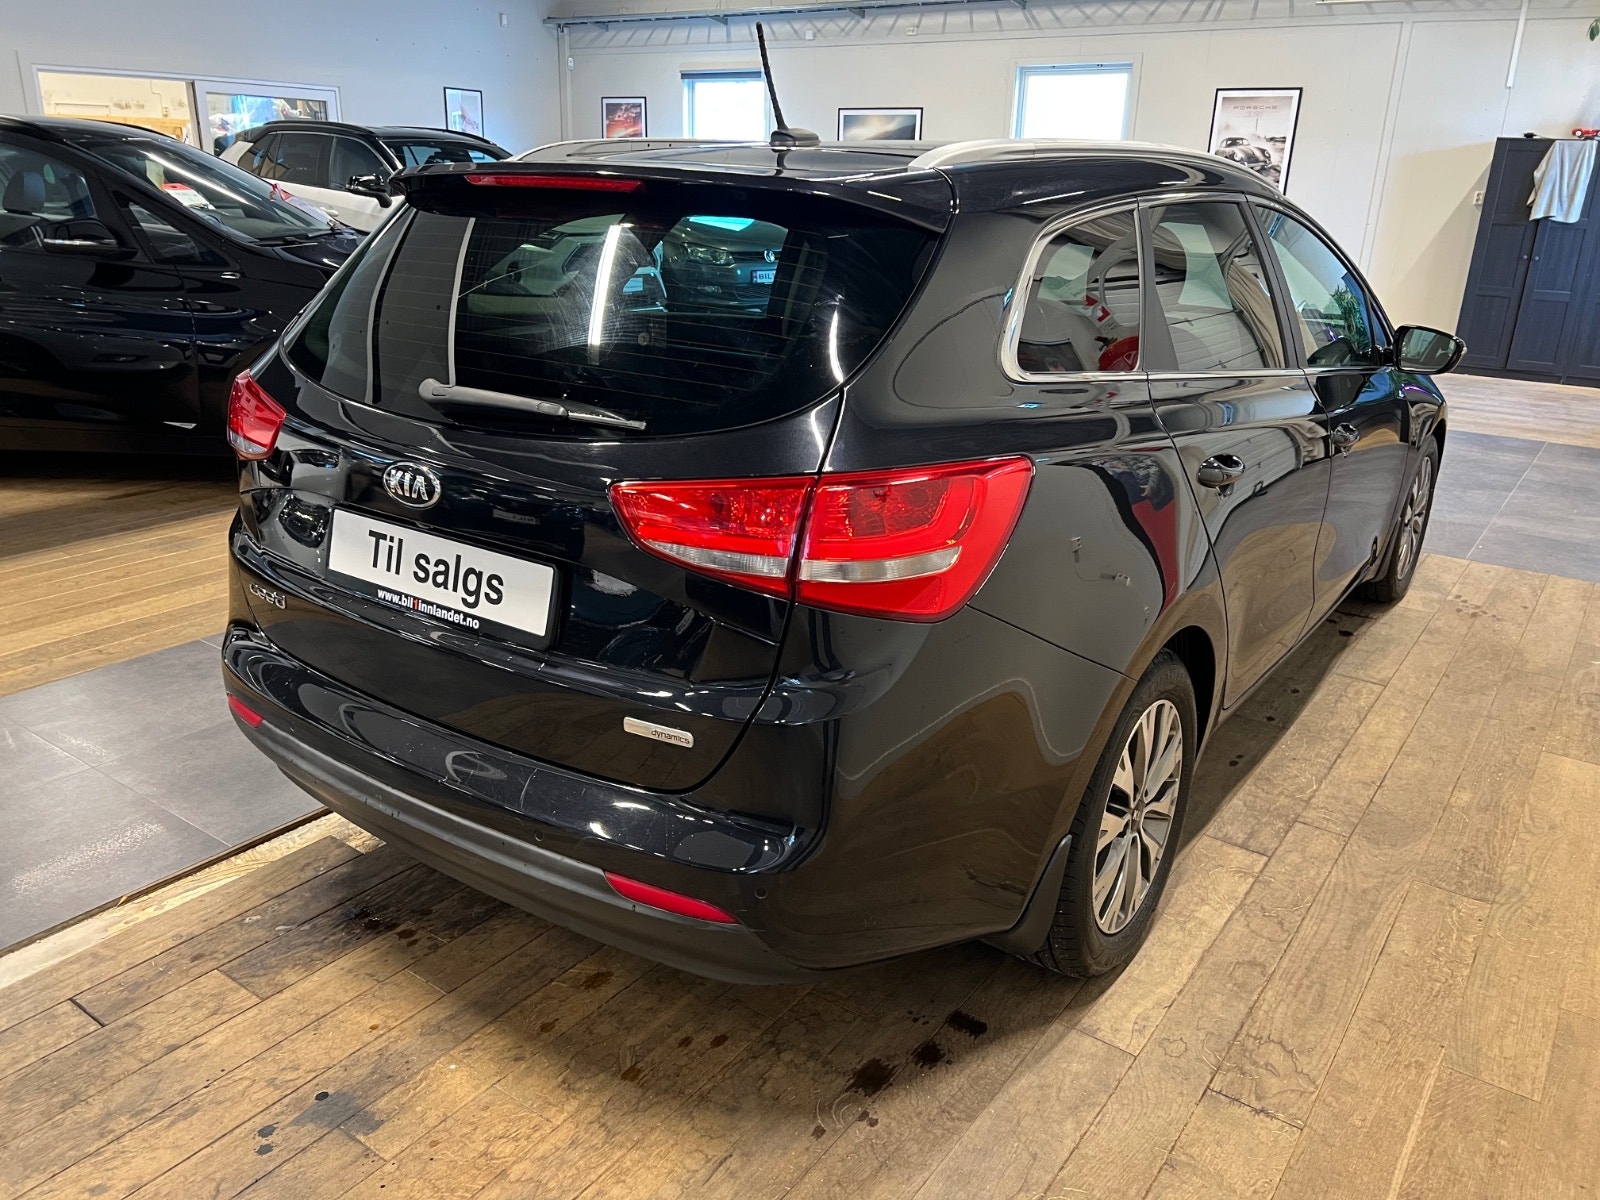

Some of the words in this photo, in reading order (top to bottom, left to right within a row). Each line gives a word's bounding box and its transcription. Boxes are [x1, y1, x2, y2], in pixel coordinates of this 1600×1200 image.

[388, 469, 429, 501] KIA
[368, 529, 404, 576] Til
[412, 552, 505, 610] salgs
[377, 589, 480, 630] www.bil1innlandet.no
[651, 729, 690, 744] dynamics
